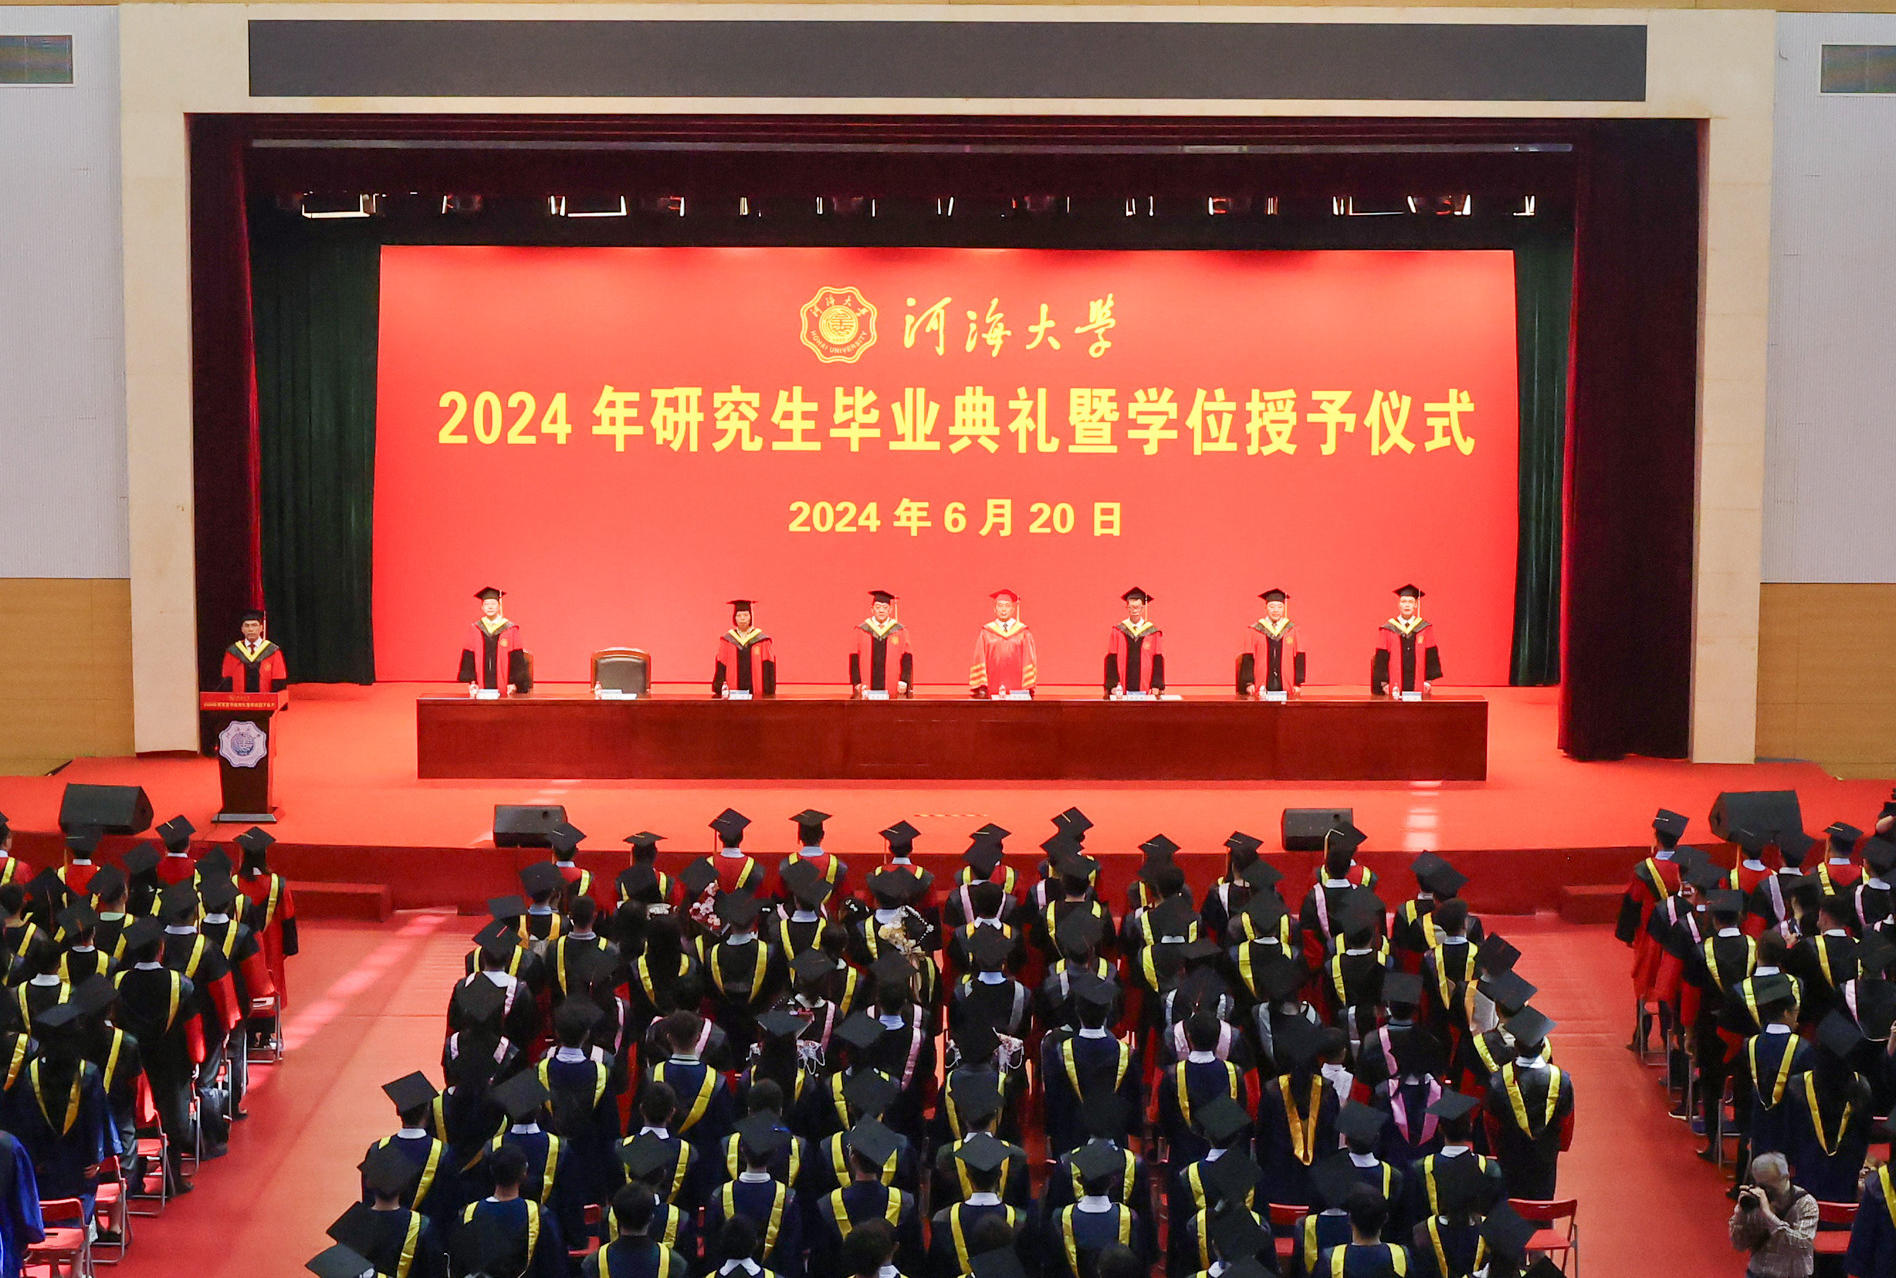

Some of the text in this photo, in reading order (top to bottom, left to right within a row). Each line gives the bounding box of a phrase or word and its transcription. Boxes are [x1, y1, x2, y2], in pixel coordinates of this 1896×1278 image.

[810, 329, 868, 354] HOHAI UNIVERSITY
[438, 384, 1476, 457] 2024 年研究生毕业典礼暨学位授予仪式
[788, 497, 1122, 537] 2024 年 6 月 20 日
